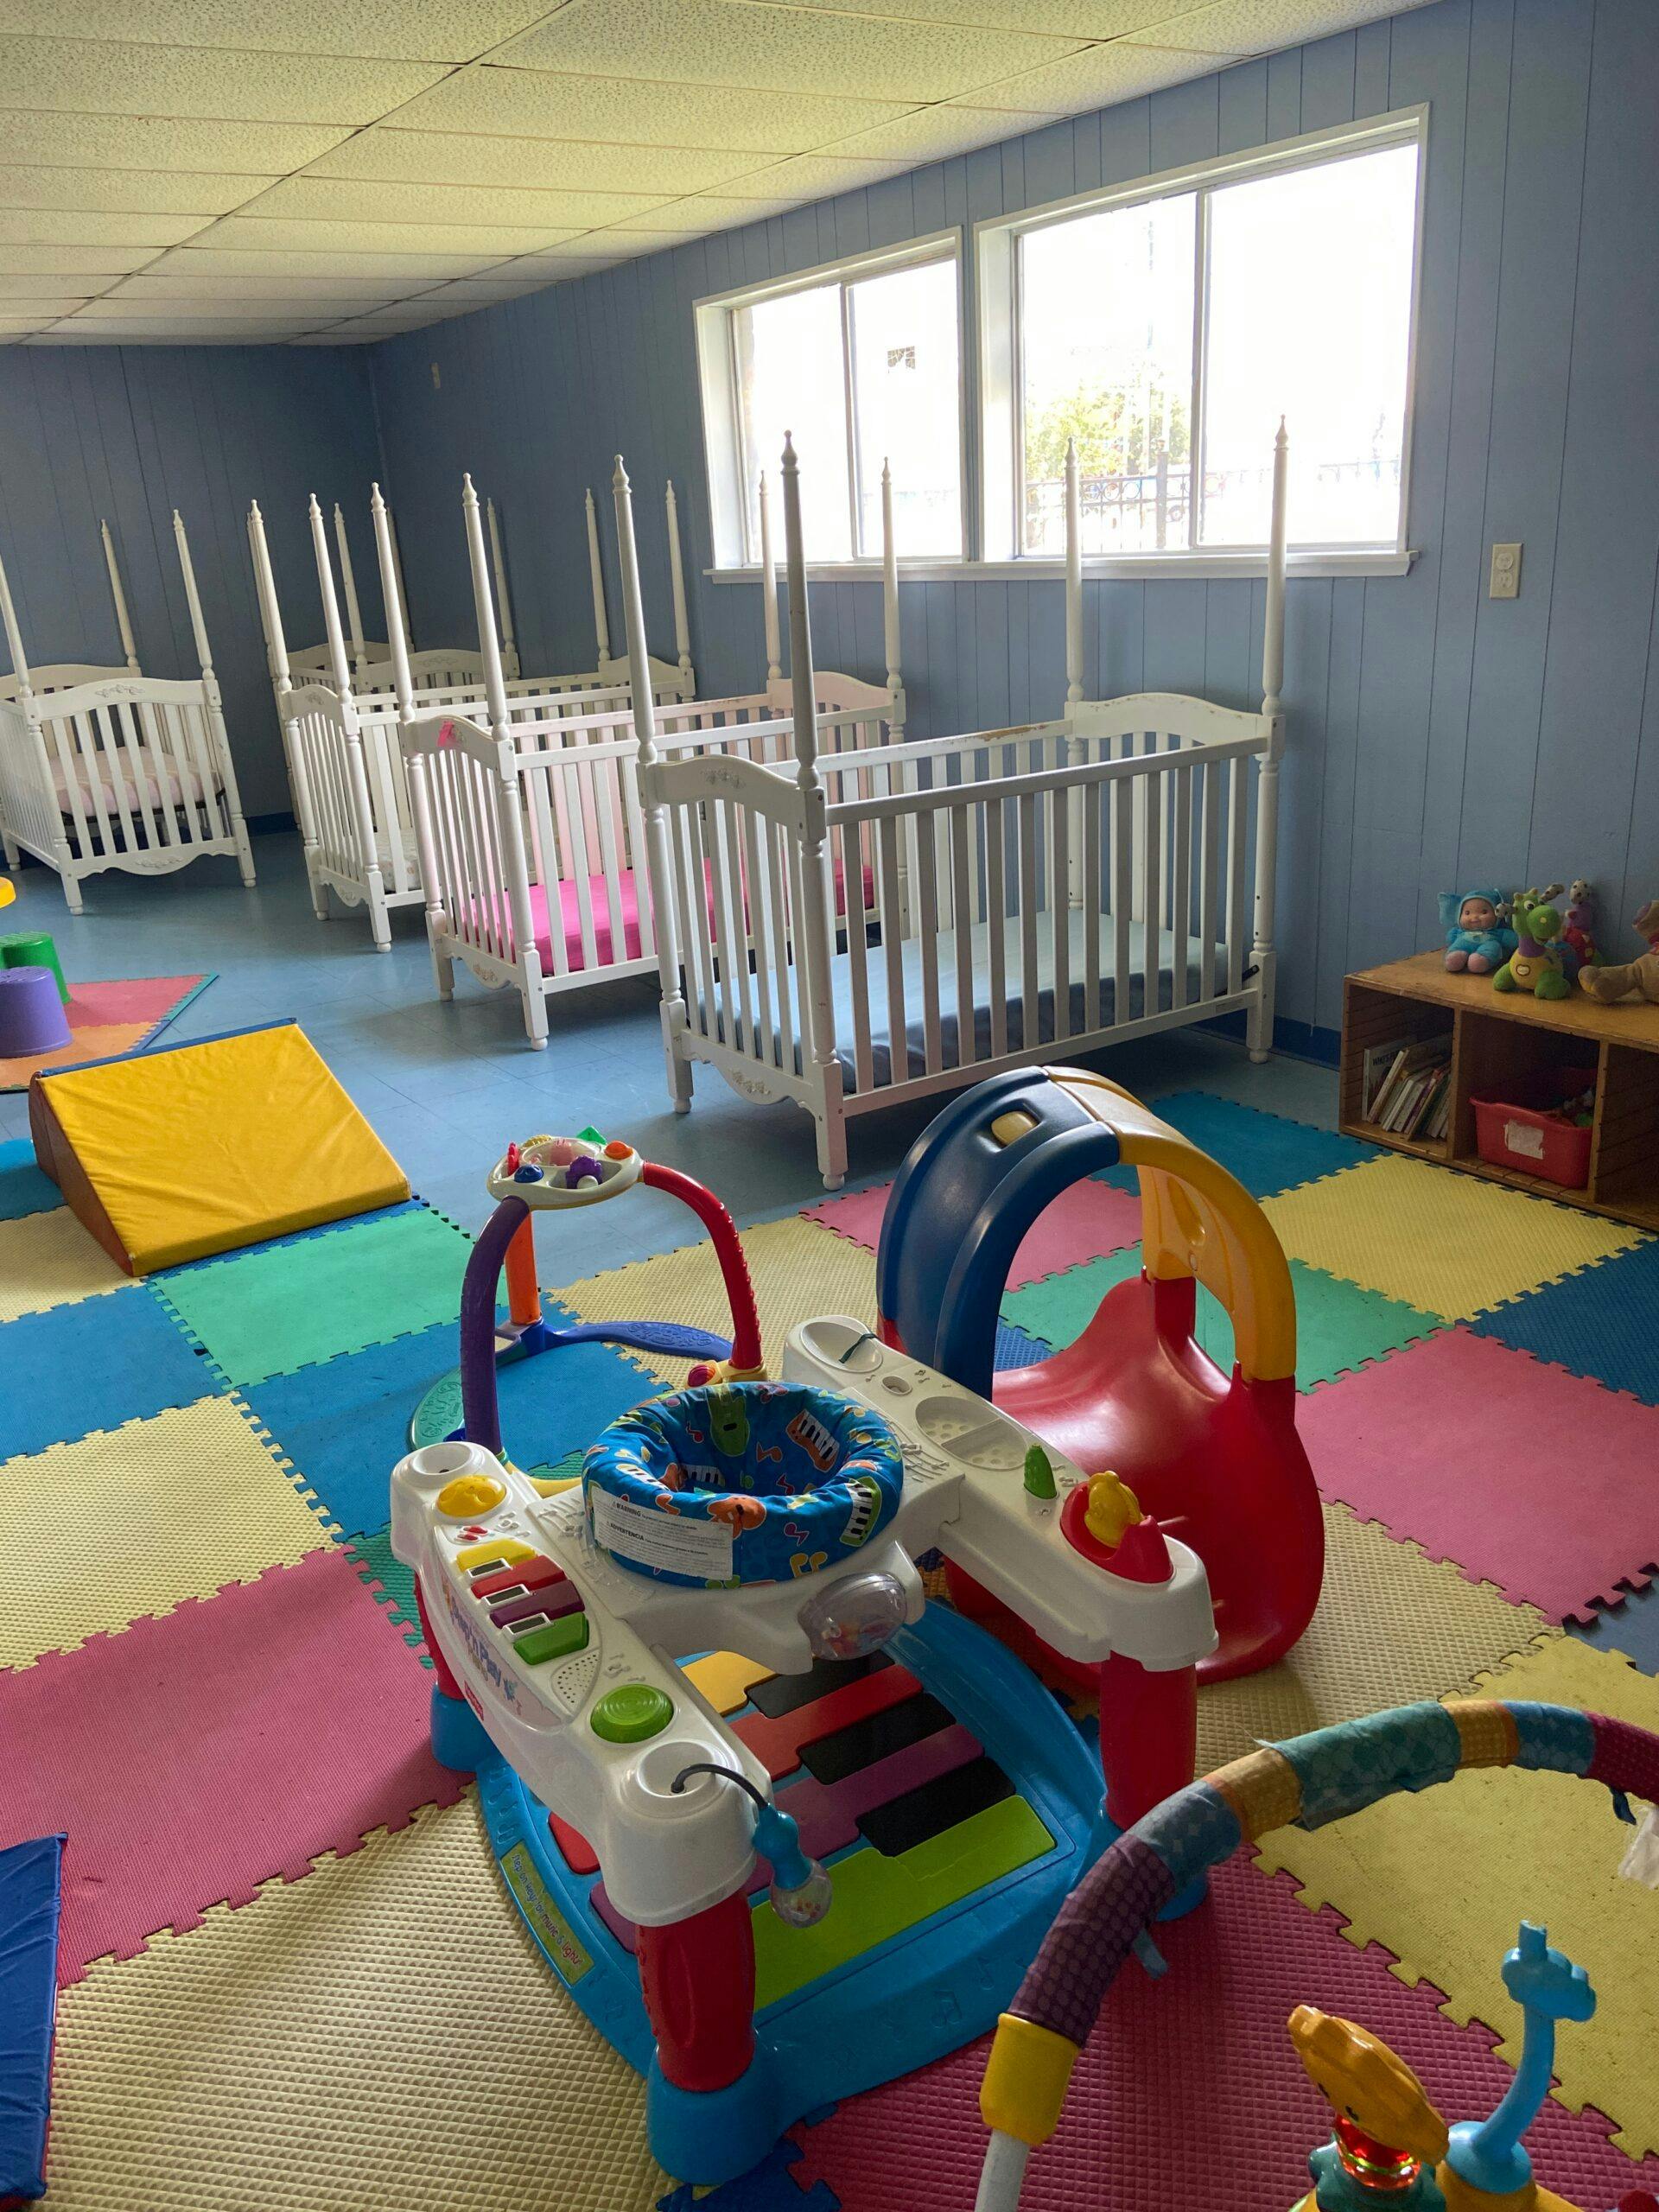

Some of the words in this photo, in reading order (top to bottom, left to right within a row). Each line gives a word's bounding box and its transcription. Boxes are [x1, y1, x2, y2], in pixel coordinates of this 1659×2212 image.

[616, 1503, 641, 1517] WARNING
[610, 1522, 645, 1541] ADVERTENCIA
[519, 1872, 528, 1884] on
[525, 1883, 537, 1902] keys
[535, 1900, 544, 1914] for
[542, 1913, 559, 1937] music
